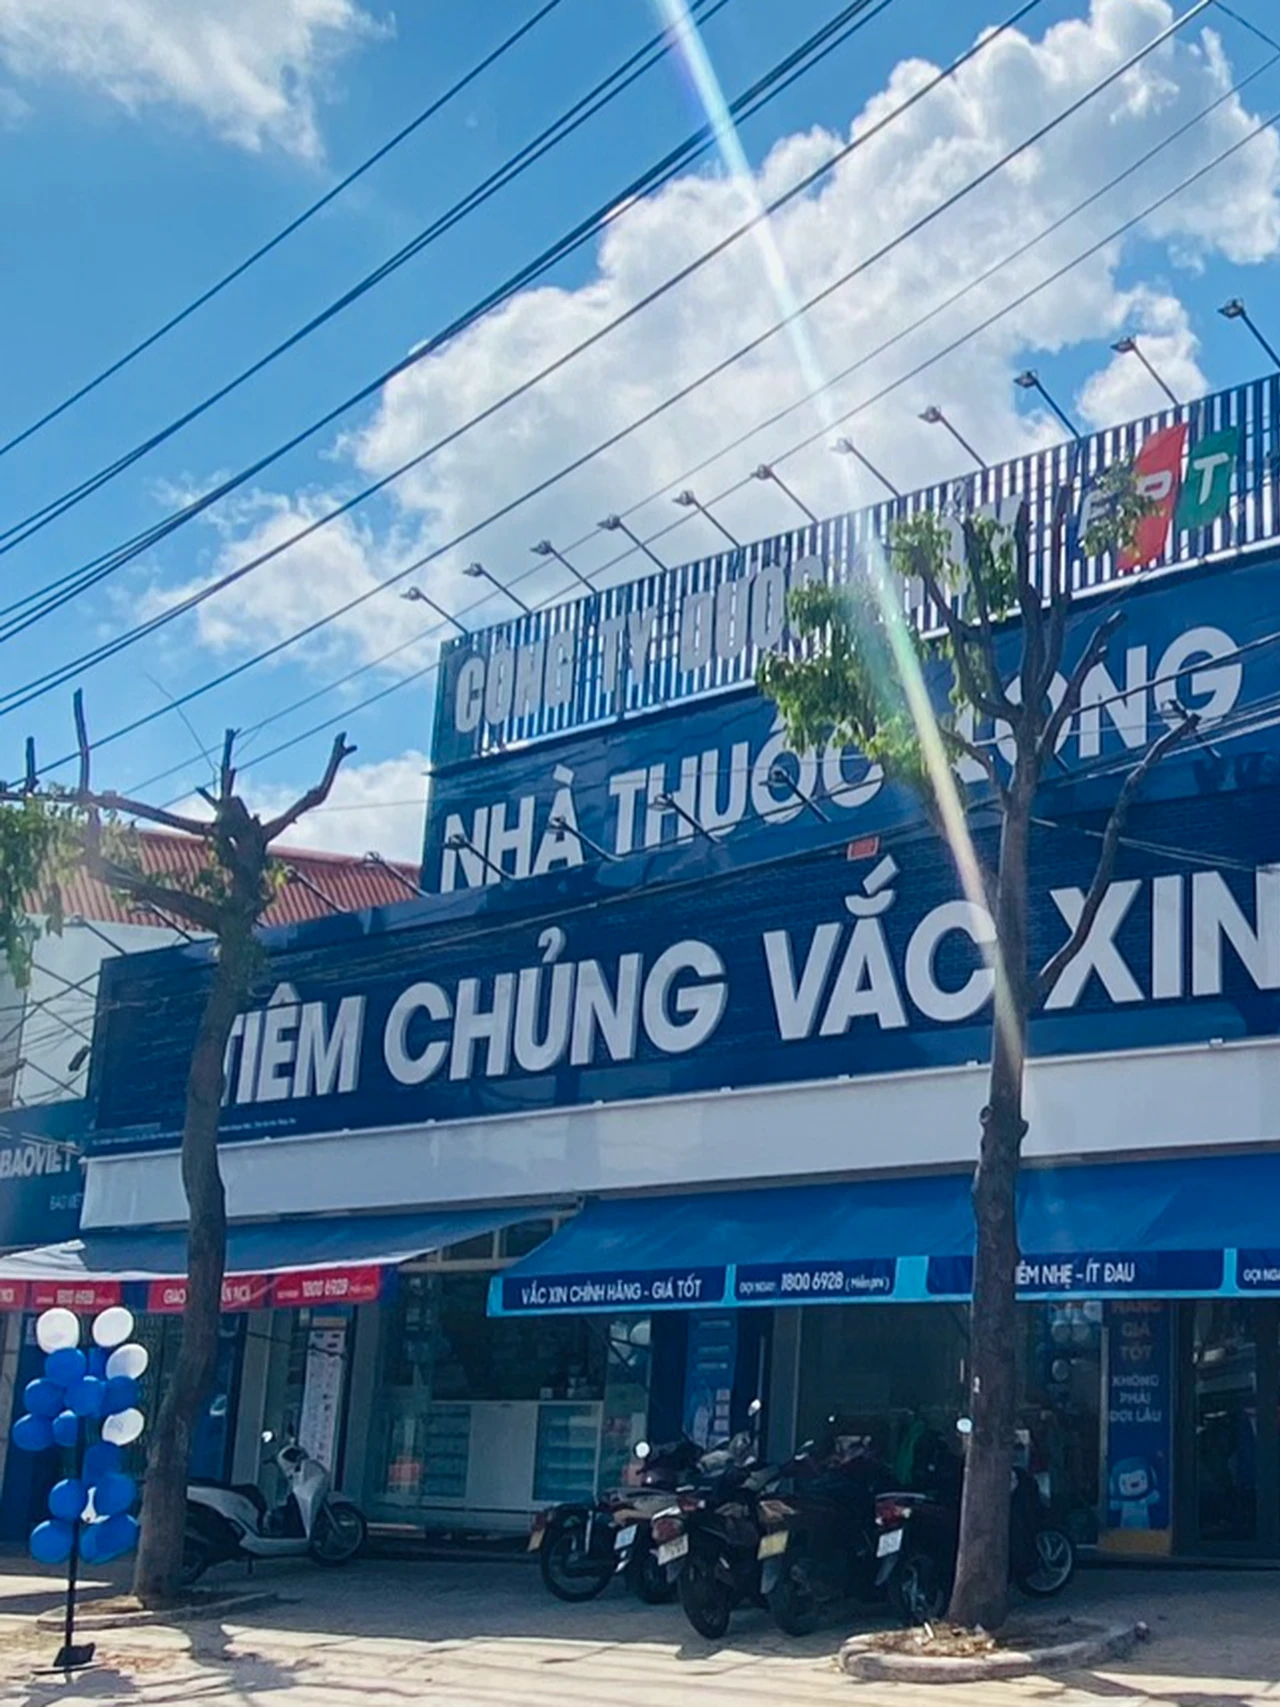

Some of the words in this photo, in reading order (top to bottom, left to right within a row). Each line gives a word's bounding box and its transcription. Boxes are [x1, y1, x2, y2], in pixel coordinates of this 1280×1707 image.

[600, 603, 659, 693] TY
[440, 763, 585, 894] NHÀ
[384, 926, 730, 1086] CHỦNG
[762, 855, 1000, 1042] VẮC
[548, 1286, 568, 1303] XIN
[651, 1276, 675, 1300] GIÁ
[677, 1272, 703, 1299] TỐT
[781, 1272, 811, 1292] 1800
[811, 1270, 844, 1291] 6928
[1041, 1263, 1074, 1290] NHẸ
[1086, 1257, 1101, 1283] ÍT
[1103, 1261, 1135, 1283] ĐAU
